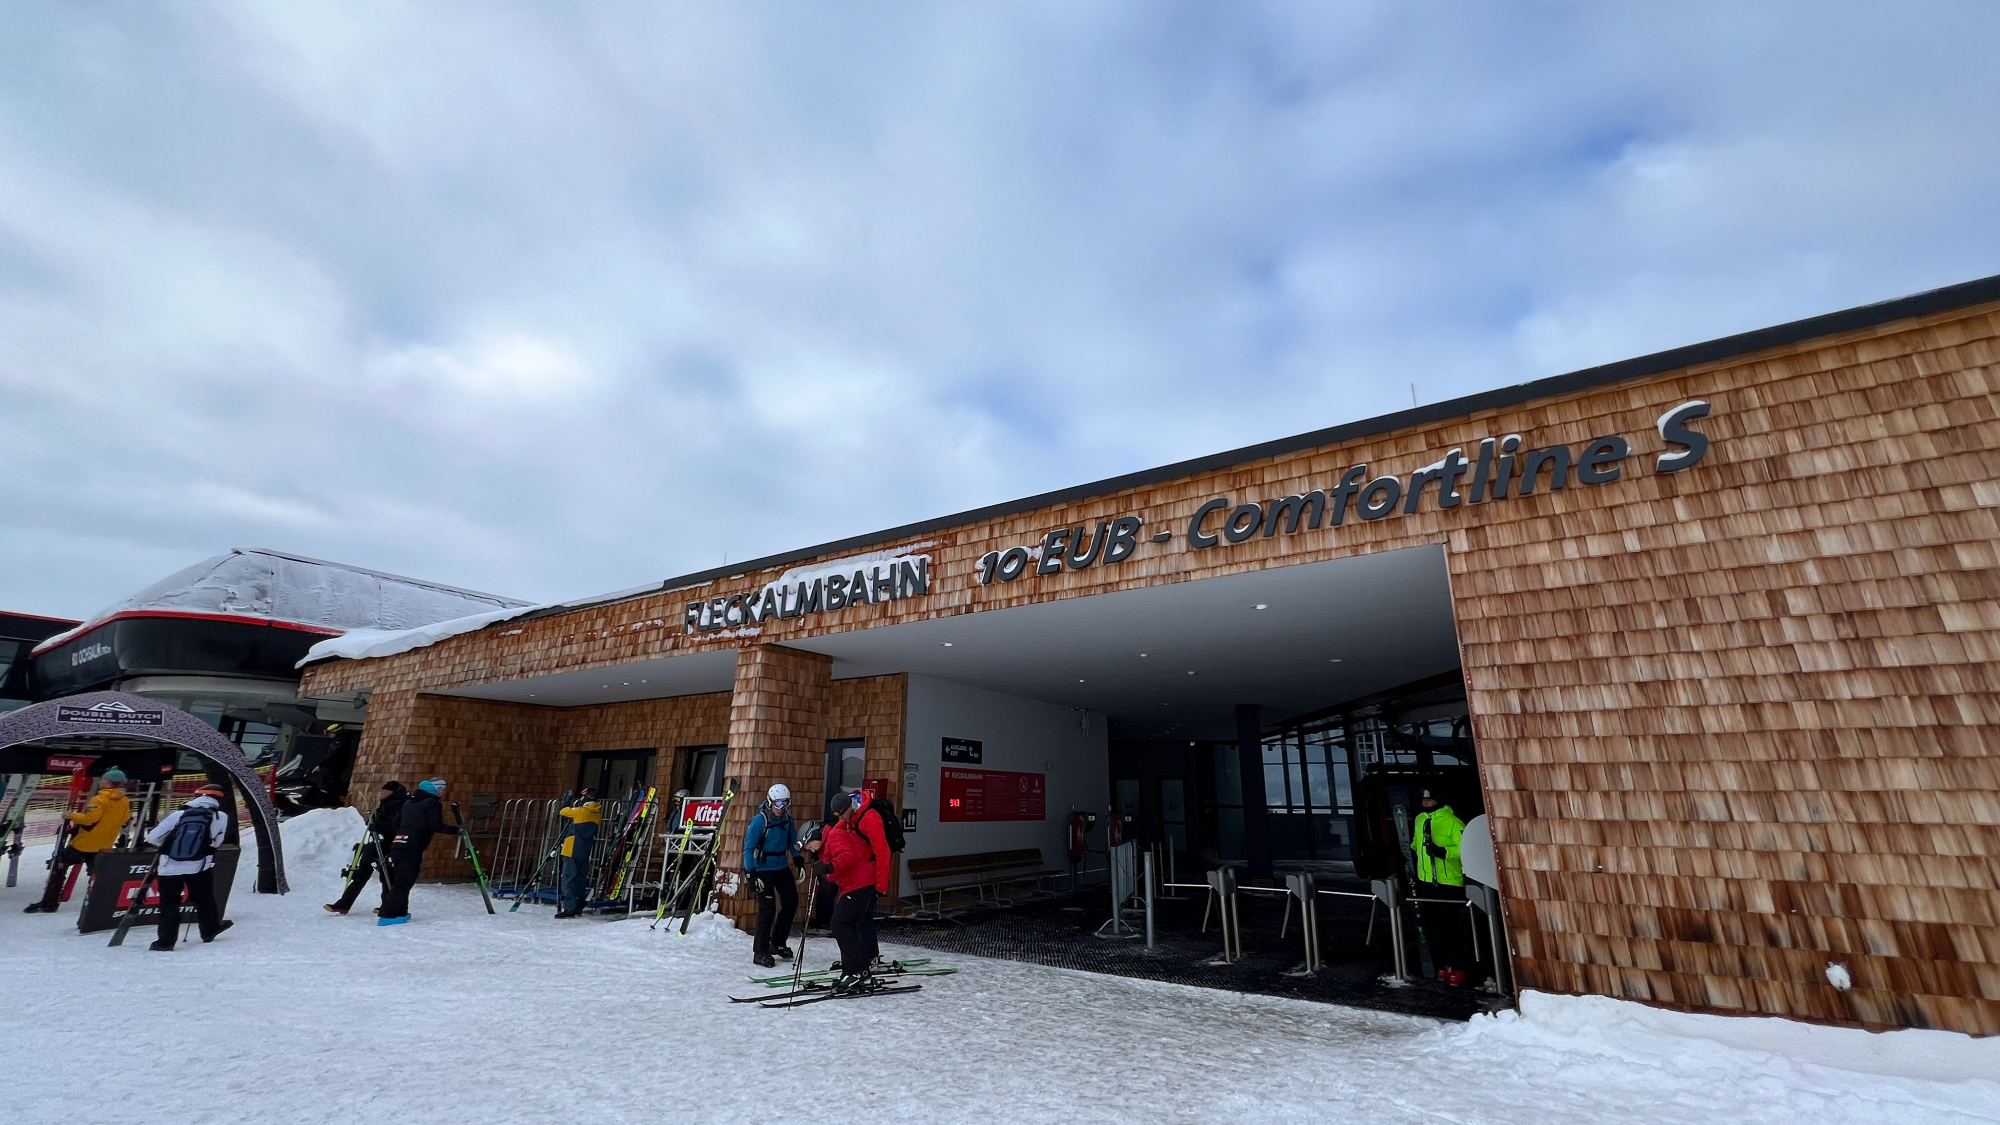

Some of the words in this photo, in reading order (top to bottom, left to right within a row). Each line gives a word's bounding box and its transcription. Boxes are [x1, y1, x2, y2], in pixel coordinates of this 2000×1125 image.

[684, 555, 928, 635] FLECKALMBAHN
[1036, 515, 1141, 575] EUB
[1187, 433, 1629, 549] Comfortline
[1654, 400, 1711, 475] S
[61, 709, 113, 718] DOUBLE
[694, 804, 724, 823] KitzS
